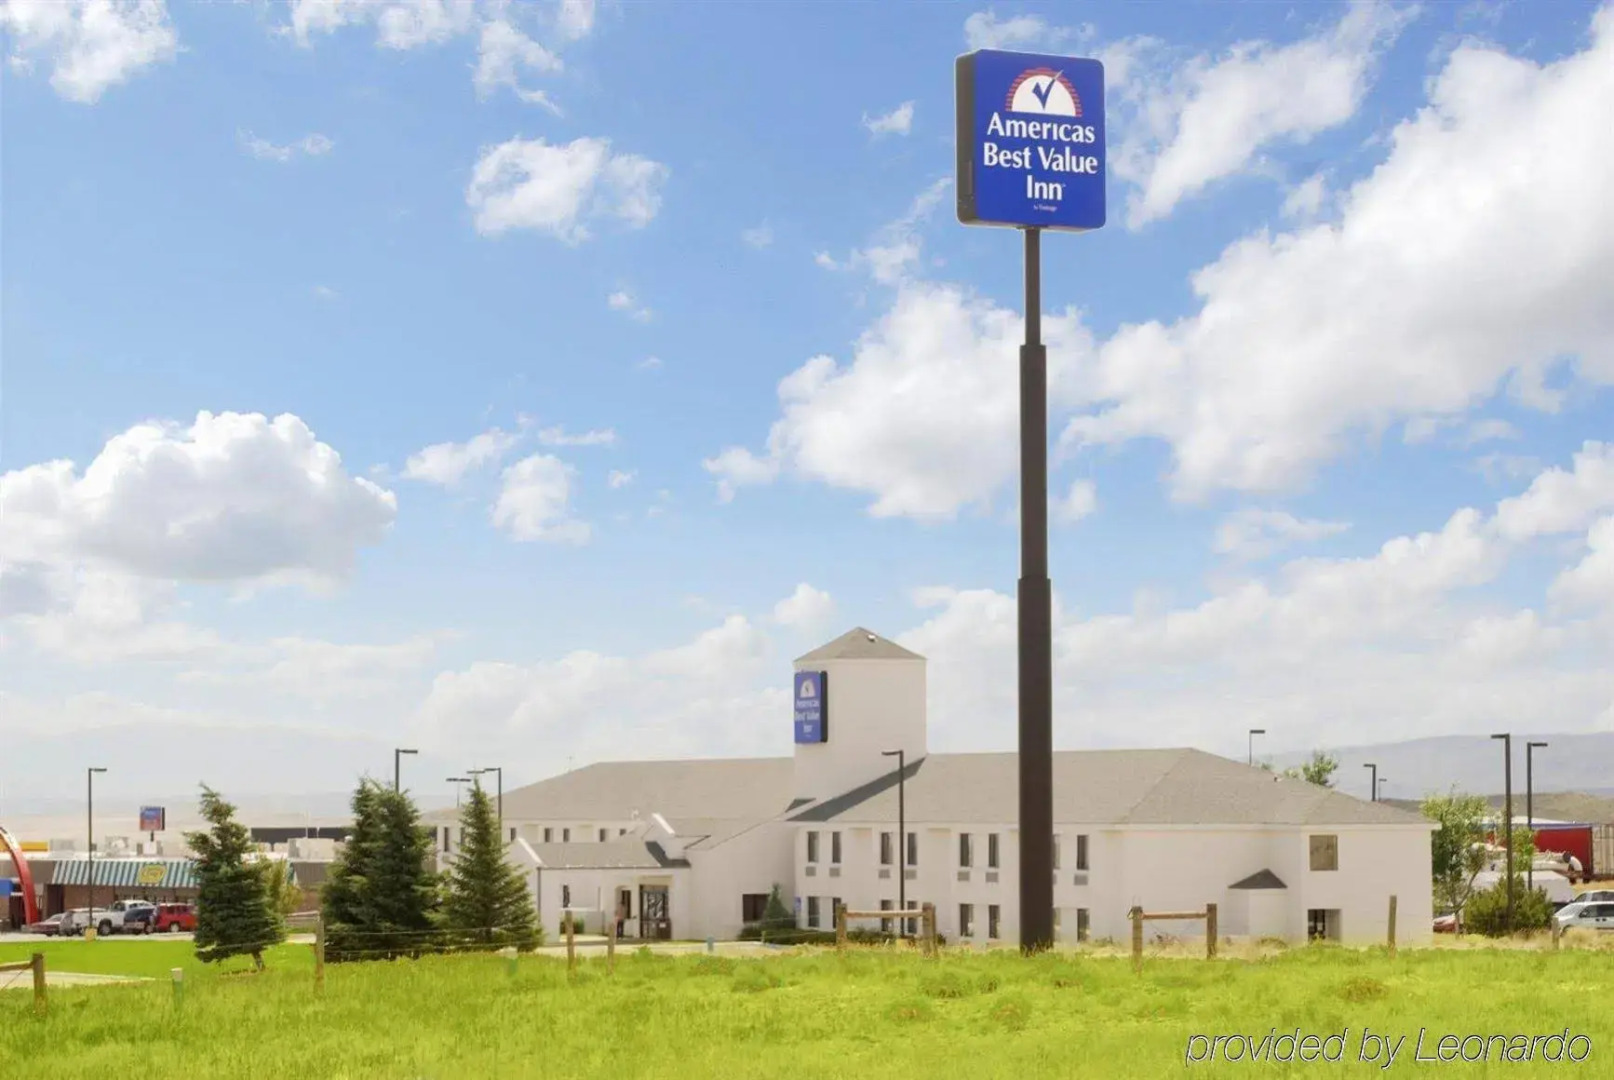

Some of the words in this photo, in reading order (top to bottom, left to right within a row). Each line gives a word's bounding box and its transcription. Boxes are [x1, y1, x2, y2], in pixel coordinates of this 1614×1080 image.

[986, 111, 1096, 144] Americas
[983, 142, 1032, 170] Best
[1037, 146, 1098, 174] Value
[1026, 174, 1063, 201] Inn
